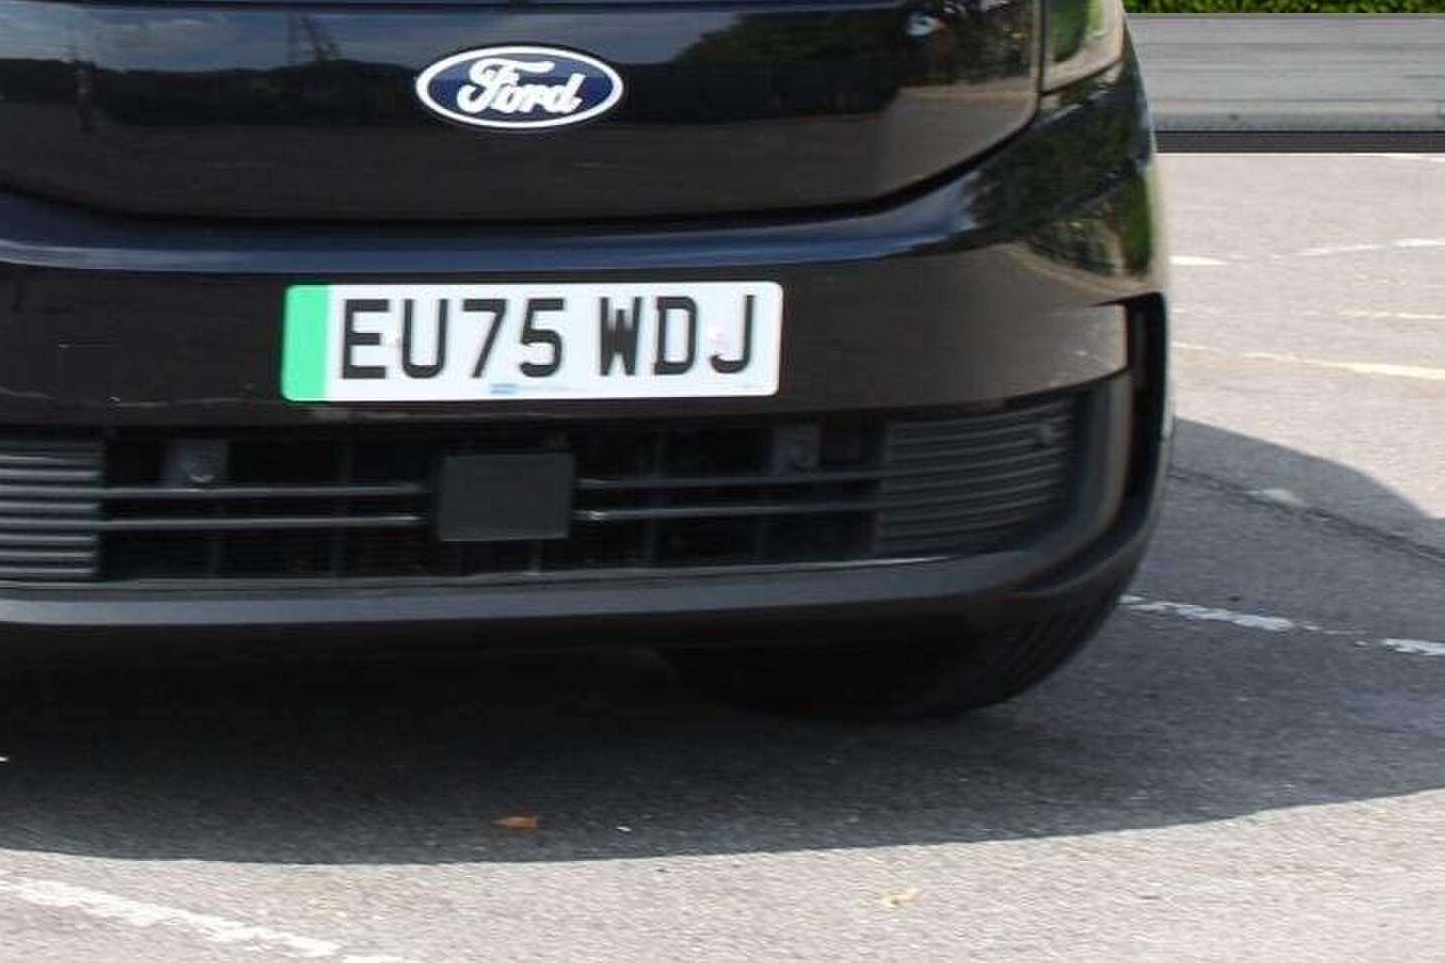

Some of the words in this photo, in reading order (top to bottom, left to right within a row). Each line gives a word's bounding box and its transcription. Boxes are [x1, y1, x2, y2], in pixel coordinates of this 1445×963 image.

[456, 57, 587, 114] Ford
[341, 297, 566, 380] EU75
[600, 294, 755, 377] WDJ
